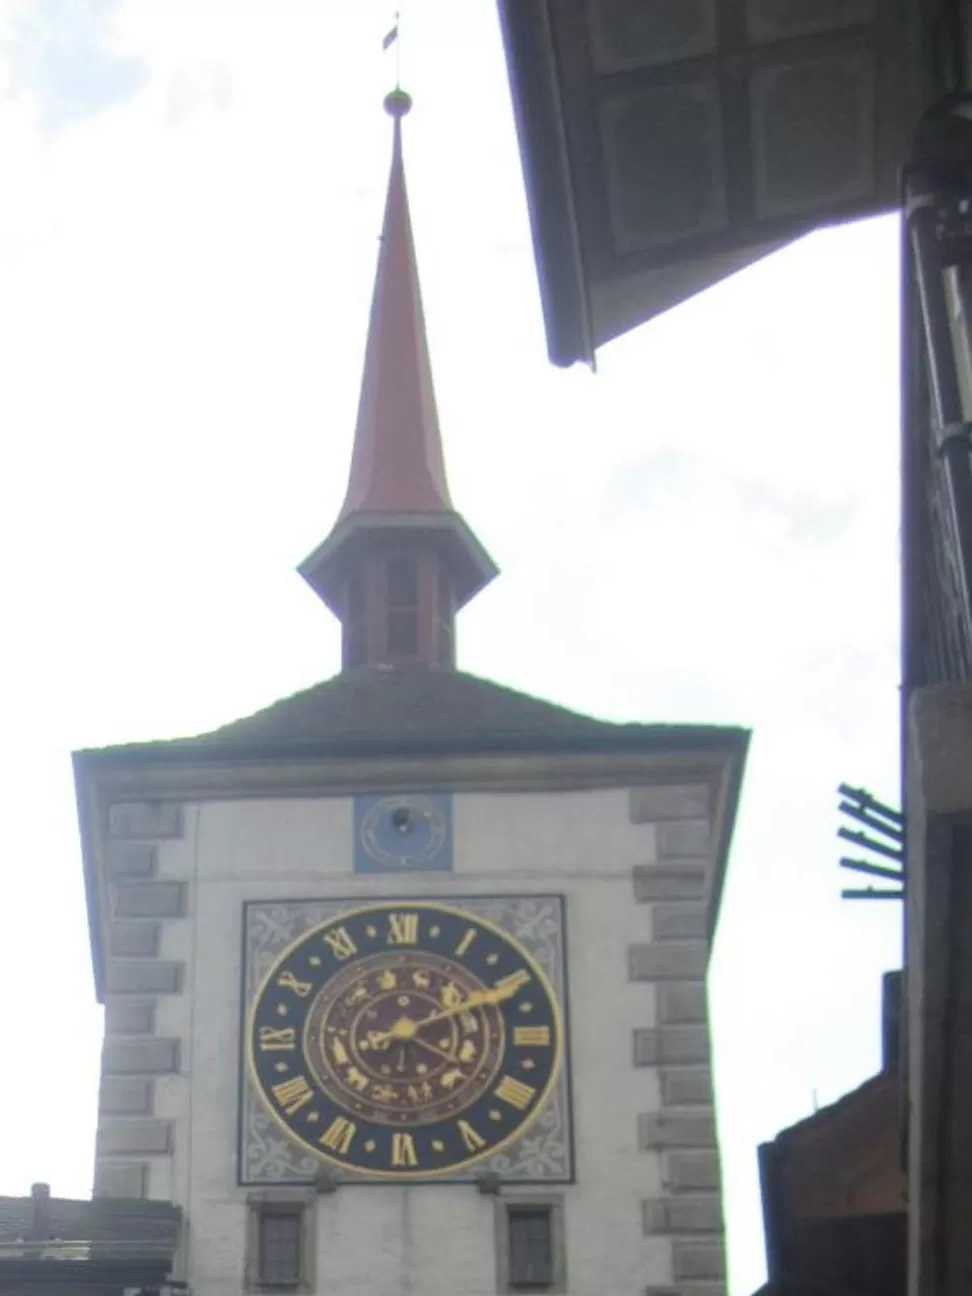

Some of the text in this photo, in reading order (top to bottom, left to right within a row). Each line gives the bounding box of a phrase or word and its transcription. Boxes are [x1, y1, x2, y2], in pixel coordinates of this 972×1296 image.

[323, 926, 358, 961] XI
[387, 913, 419, 945] XII
[392, 1131, 419, 1167] VI
[457, 1119, 487, 1153] V
